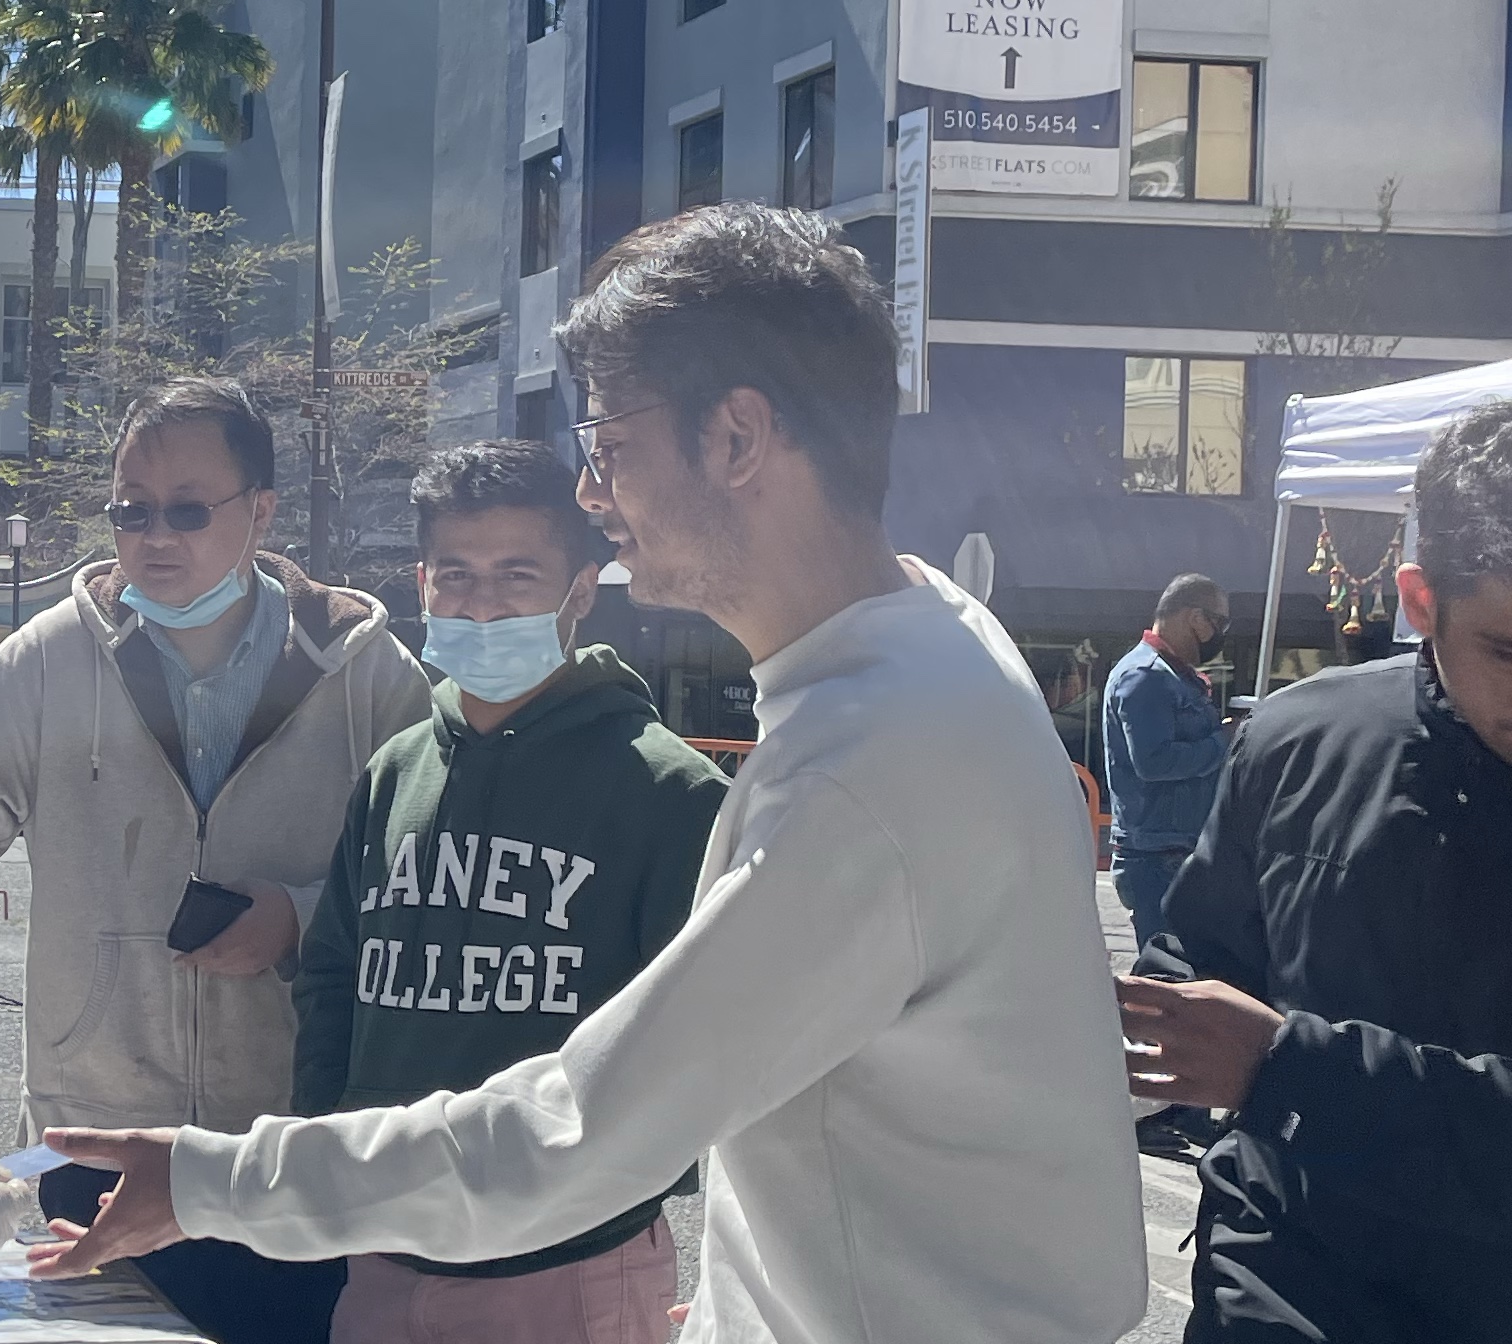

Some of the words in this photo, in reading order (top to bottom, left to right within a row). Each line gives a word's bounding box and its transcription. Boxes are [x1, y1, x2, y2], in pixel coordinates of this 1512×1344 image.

[946, 12, 1080, 40] LEASING
[944, 109, 1078, 134] 510.540.5454
[333, 372, 397, 386] KITTREDGE
[357, 937, 584, 1014] OLLEGE
